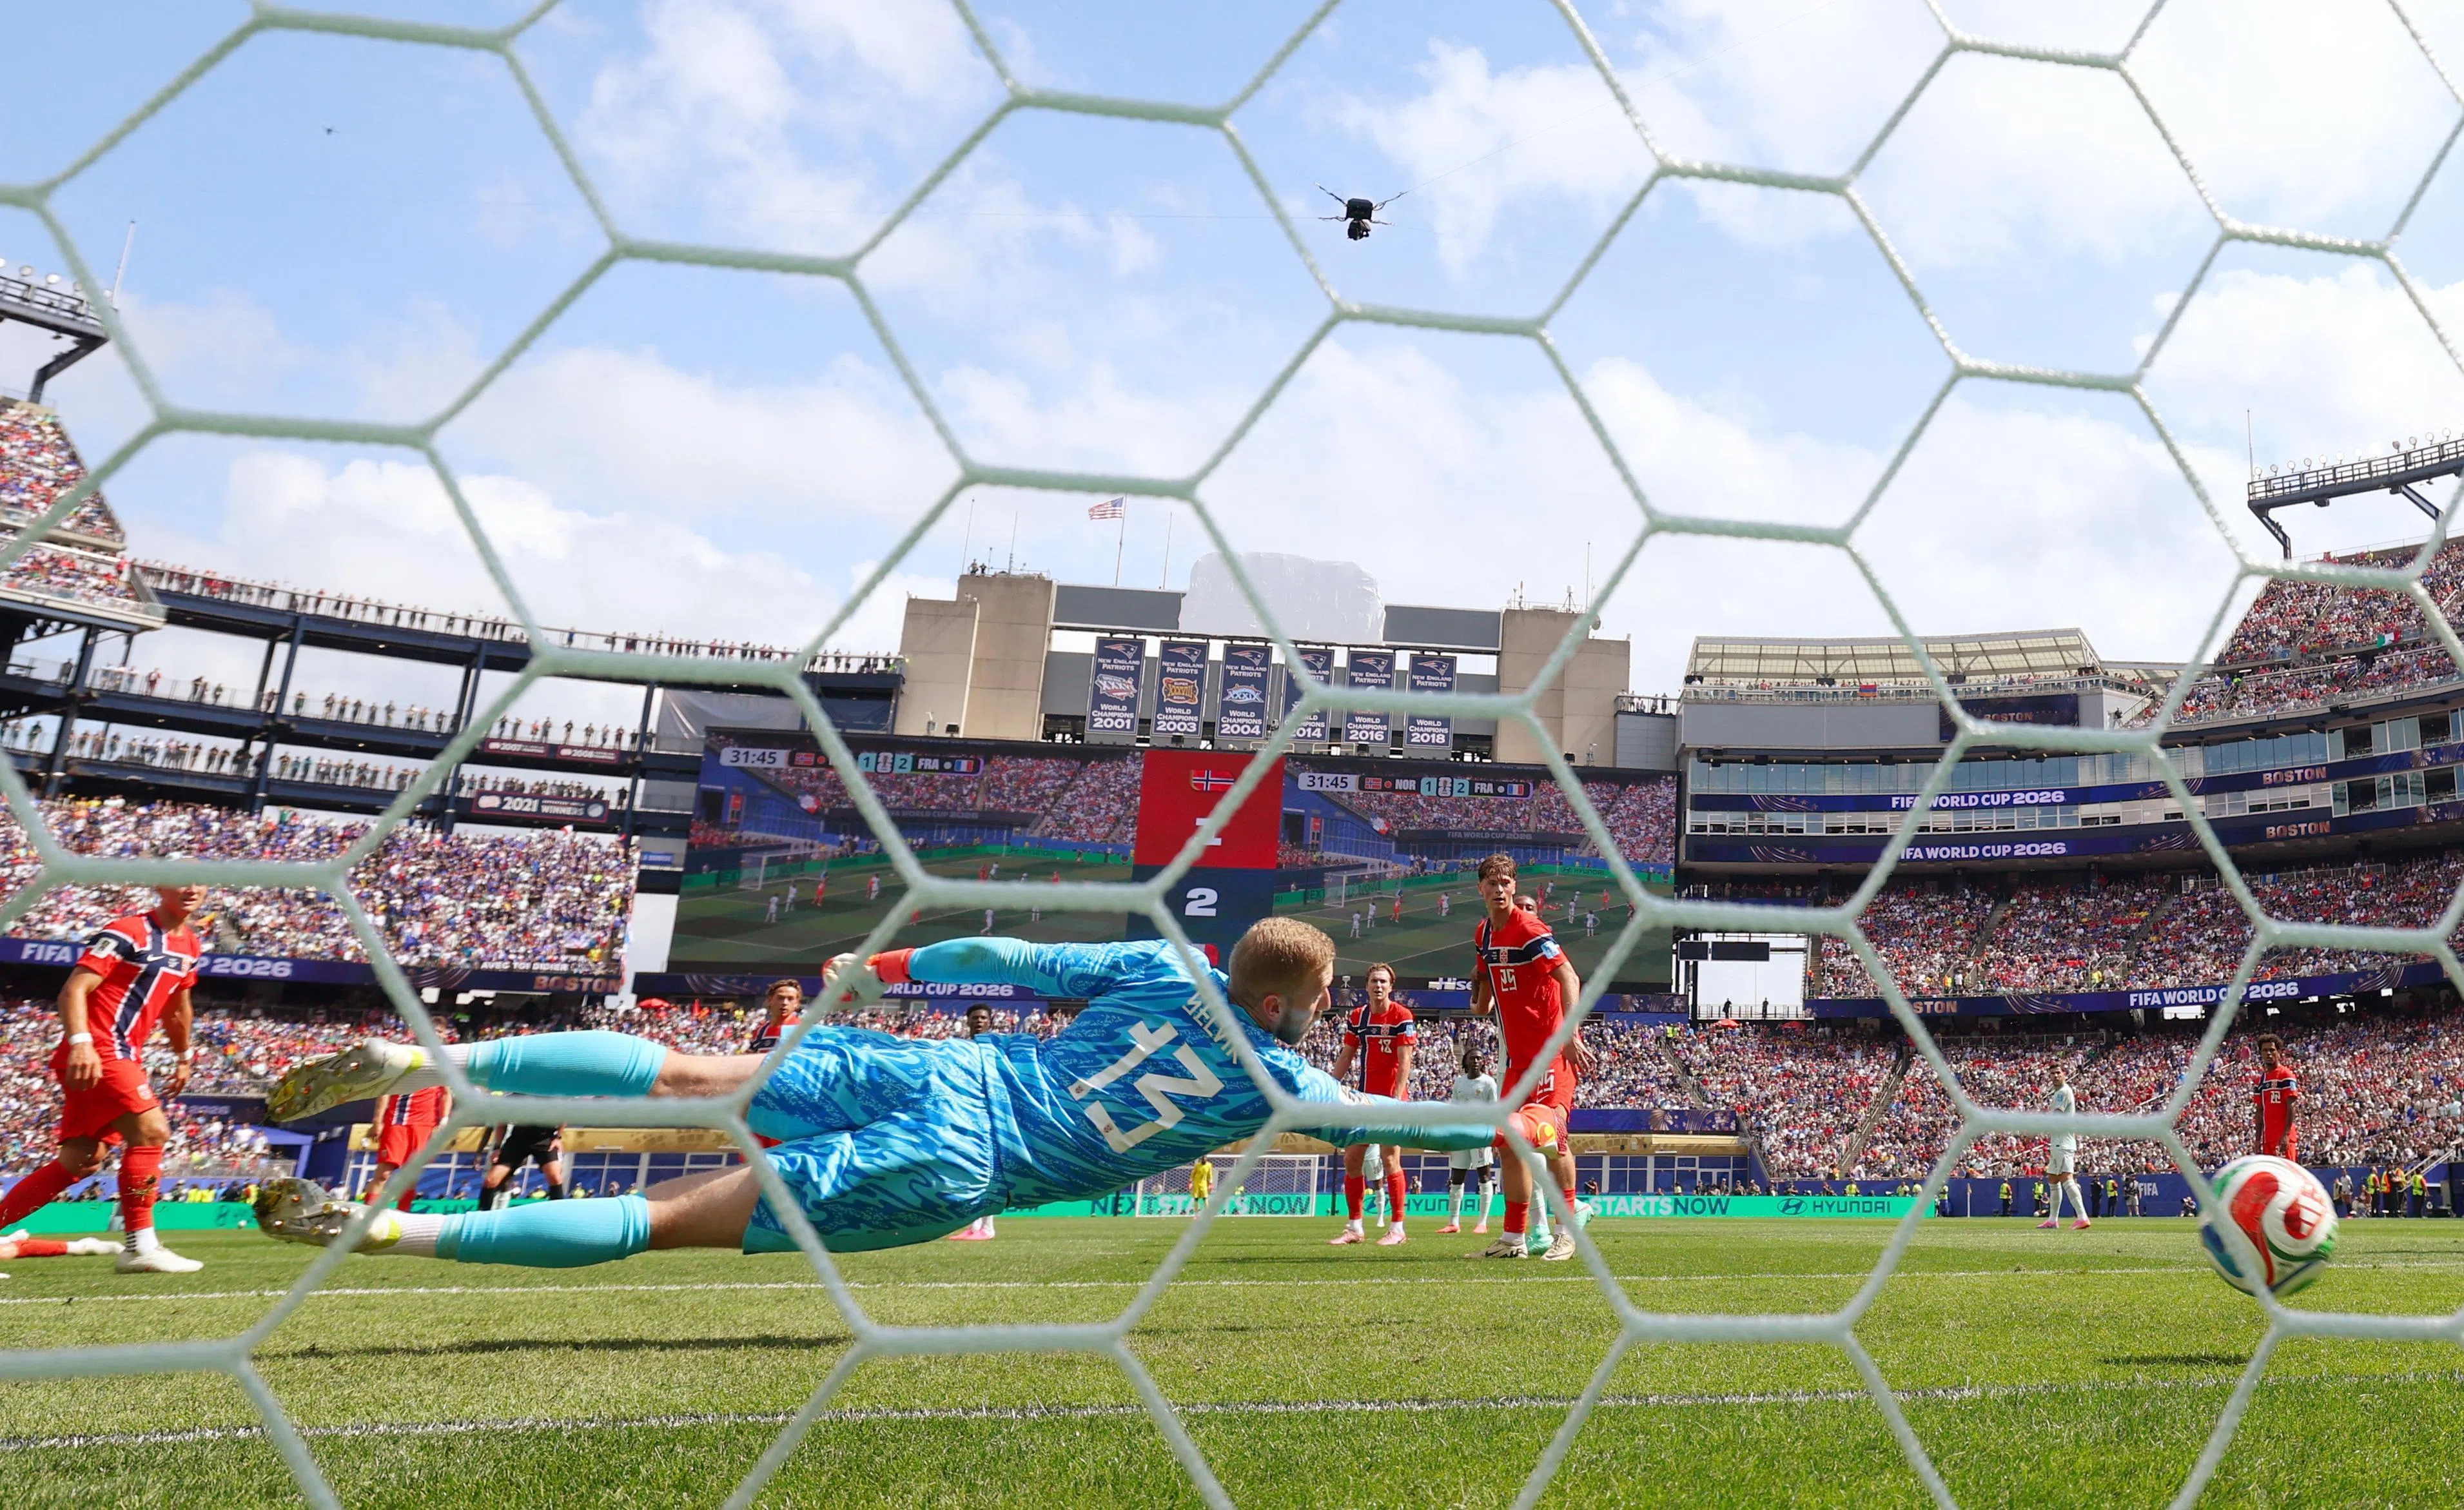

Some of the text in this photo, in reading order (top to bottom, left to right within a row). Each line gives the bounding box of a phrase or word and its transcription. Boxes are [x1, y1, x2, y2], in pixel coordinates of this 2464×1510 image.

[1093, 718, 1131, 729] 2001
[1157, 721, 1197, 732] 2003
[1220, 725, 1260, 735] 2004
[1349, 730, 1385, 740] 2016
[1411, 733, 1445, 743] 2018
[730, 750, 776, 765] 31:45
[864, 757, 871, 769] 1
[899, 758, 939, 770] 2 FRA
[2263, 766, 2326, 785] BOSTON
[1307, 775, 1431, 792] 31:45 NOR 1
[1457, 783, 1493, 794] 2 FRA
[502, 796, 540, 812] 2021
[1980, 793, 2010, 806] CUP
[2013, 790, 2066, 805] 2026
[540, 805, 585, 816] WINNERS
[2265, 820, 2331, 838] BOSTON
[1901, 842, 2066, 859] IFA WORLD CUP 2026
[1185, 887, 1218, 917] 2
[21, 943, 73, 962] FIFA
[211, 957, 294, 977] 2026
[532, 963, 569, 971] DIDIER
[534, 976, 620, 993] BOSTON
[926, 984, 957, 995] CUP
[959, 985, 1013, 996] 2026
[2130, 992, 2161, 1006] FIFA
[2163, 989, 2216, 1005] WORLD
[2249, 982, 2299, 998] 2026
[1378, 1039, 1392, 1054] 18
[1068, 1021, 1224, 1154] 13
[2138, 1182, 2158, 1197] FIFA
[1404, 1198, 1480, 1211] HYUNAI
[1813, 1201, 1891, 1213] HYUNDAI
